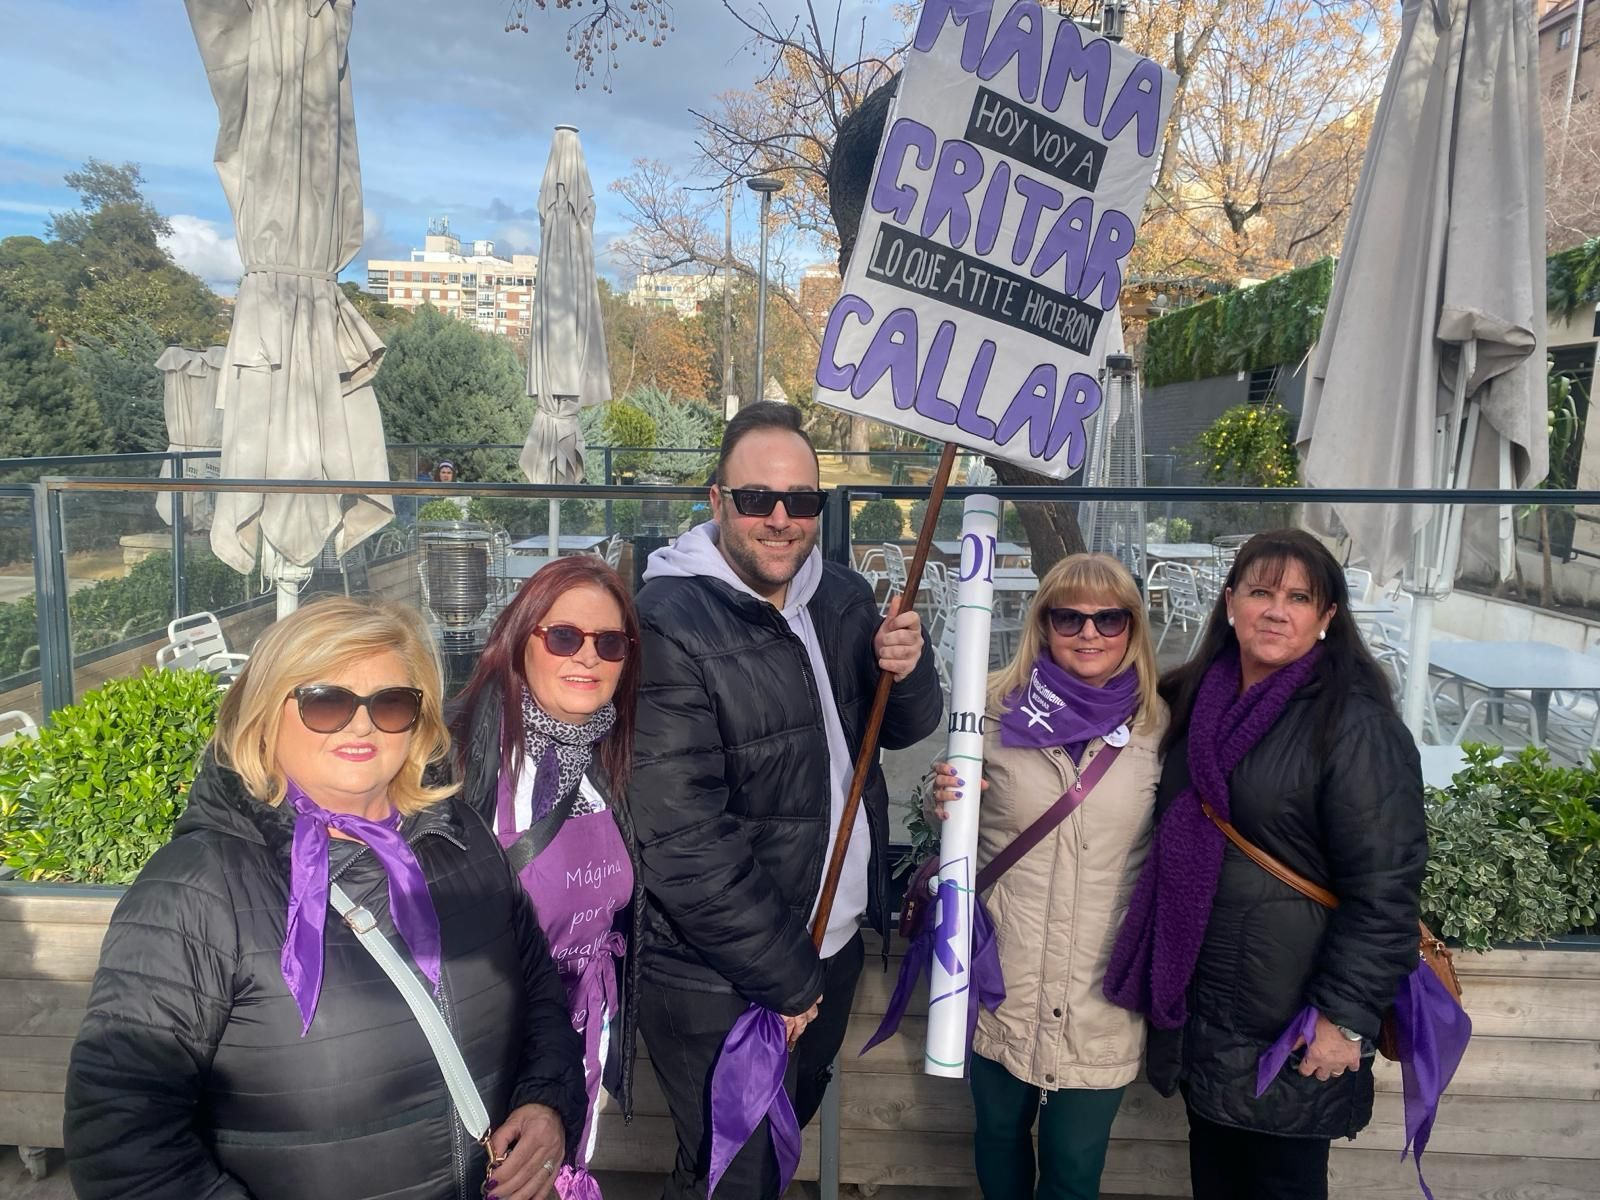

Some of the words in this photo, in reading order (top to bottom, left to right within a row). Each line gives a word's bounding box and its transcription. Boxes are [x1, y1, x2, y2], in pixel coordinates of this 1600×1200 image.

[913, 0, 1162, 158] MAMA
[975, 93, 1029, 147] HOY
[1033, 123, 1077, 169] VOY
[1071, 150, 1094, 183] A
[872, 118, 1136, 311] GRITAR
[870, 230, 904, 278] LO
[902, 247, 946, 291] QUE
[1020, 288, 1095, 349] HICIERON
[816, 294, 1102, 469] CALLAR
[566, 859, 622, 889] Mágina
[569, 906, 603, 935] por
